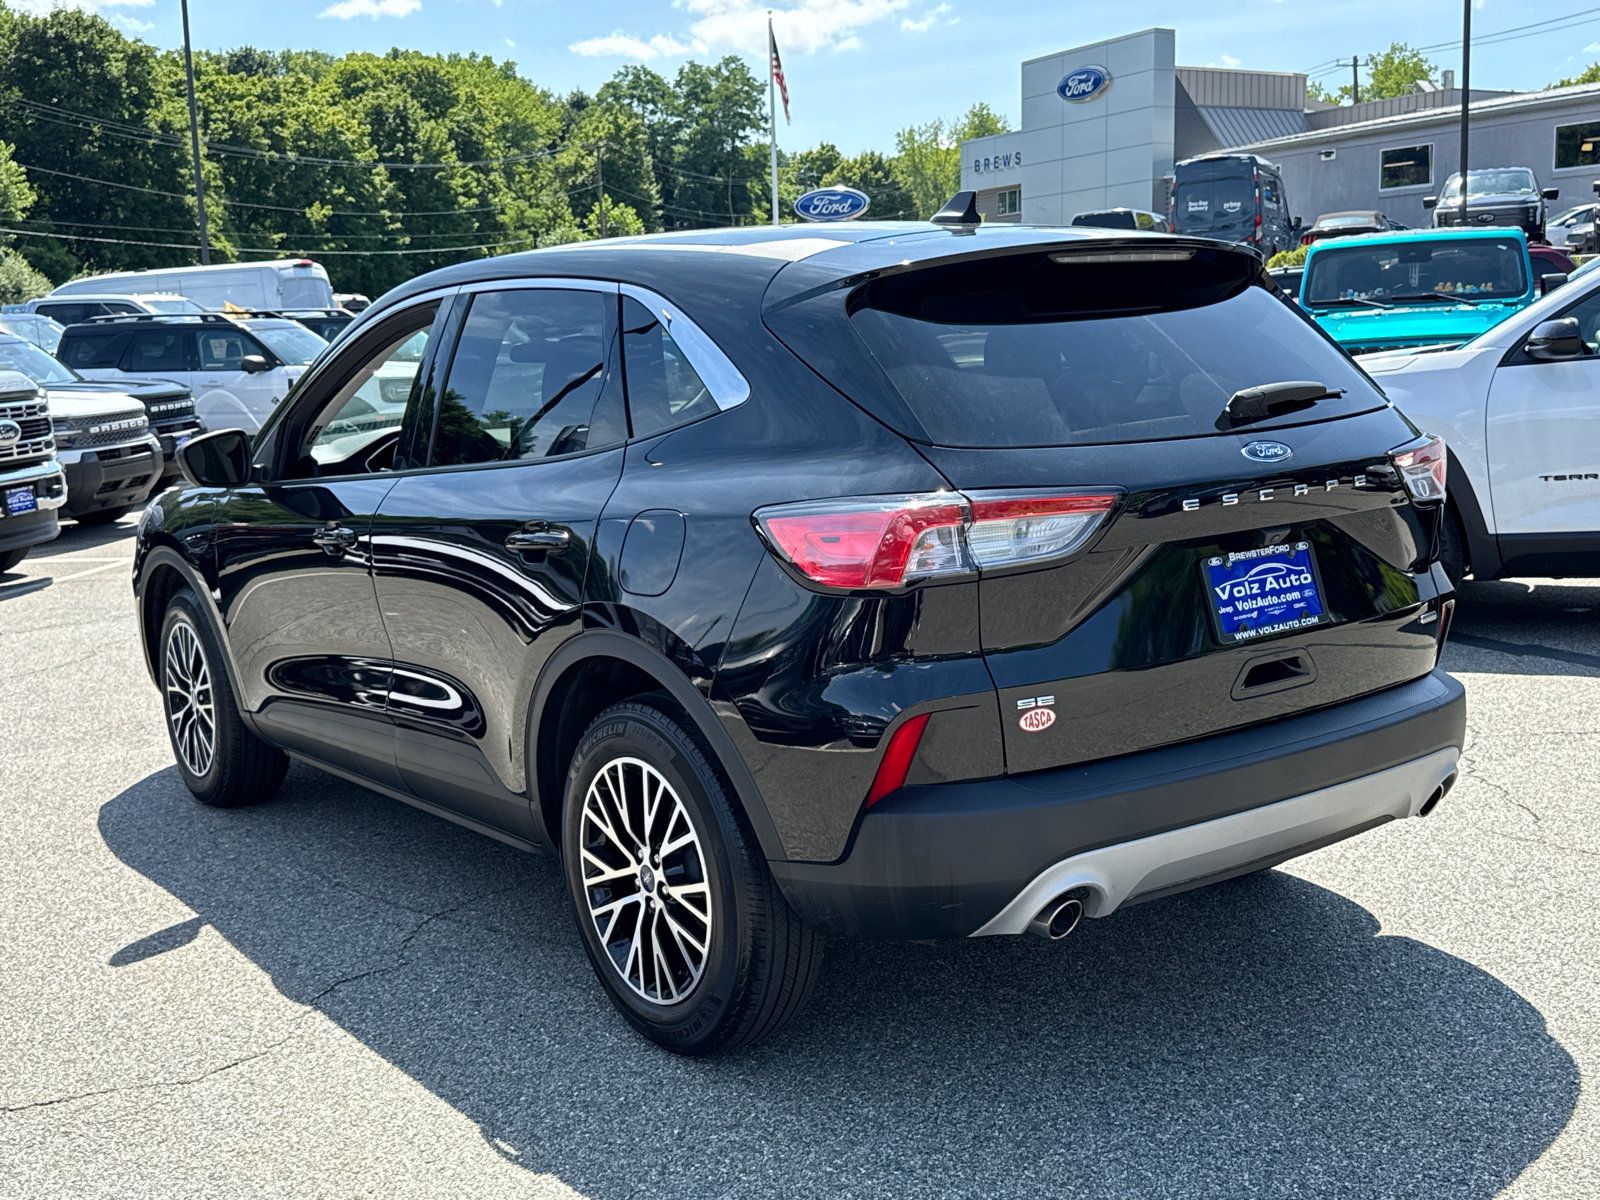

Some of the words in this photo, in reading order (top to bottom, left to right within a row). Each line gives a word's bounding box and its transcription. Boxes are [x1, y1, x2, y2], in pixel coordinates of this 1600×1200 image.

[1065, 74, 1095, 97] Ford
[974, 151, 1022, 173] BREWS
[809, 195, 852, 215] Ford
[1223, 201, 1241, 209] prime
[89, 420, 144, 434] BRONCO
[1255, 443, 1284, 457] Ford
[1182, 474, 1367, 512] ESCAPE
[1215, 581, 1261, 601] Volz
[1265, 573, 1312, 592] Auto
[1218, 605, 1234, 614] Jeep
[1235, 591, 1301, 611] VolzAuto.com
[1234, 616, 1319, 640] WWW.VOLZAUTO.COM
[1017, 695, 1055, 710] SE
[1023, 710, 1052, 729] TASCA
